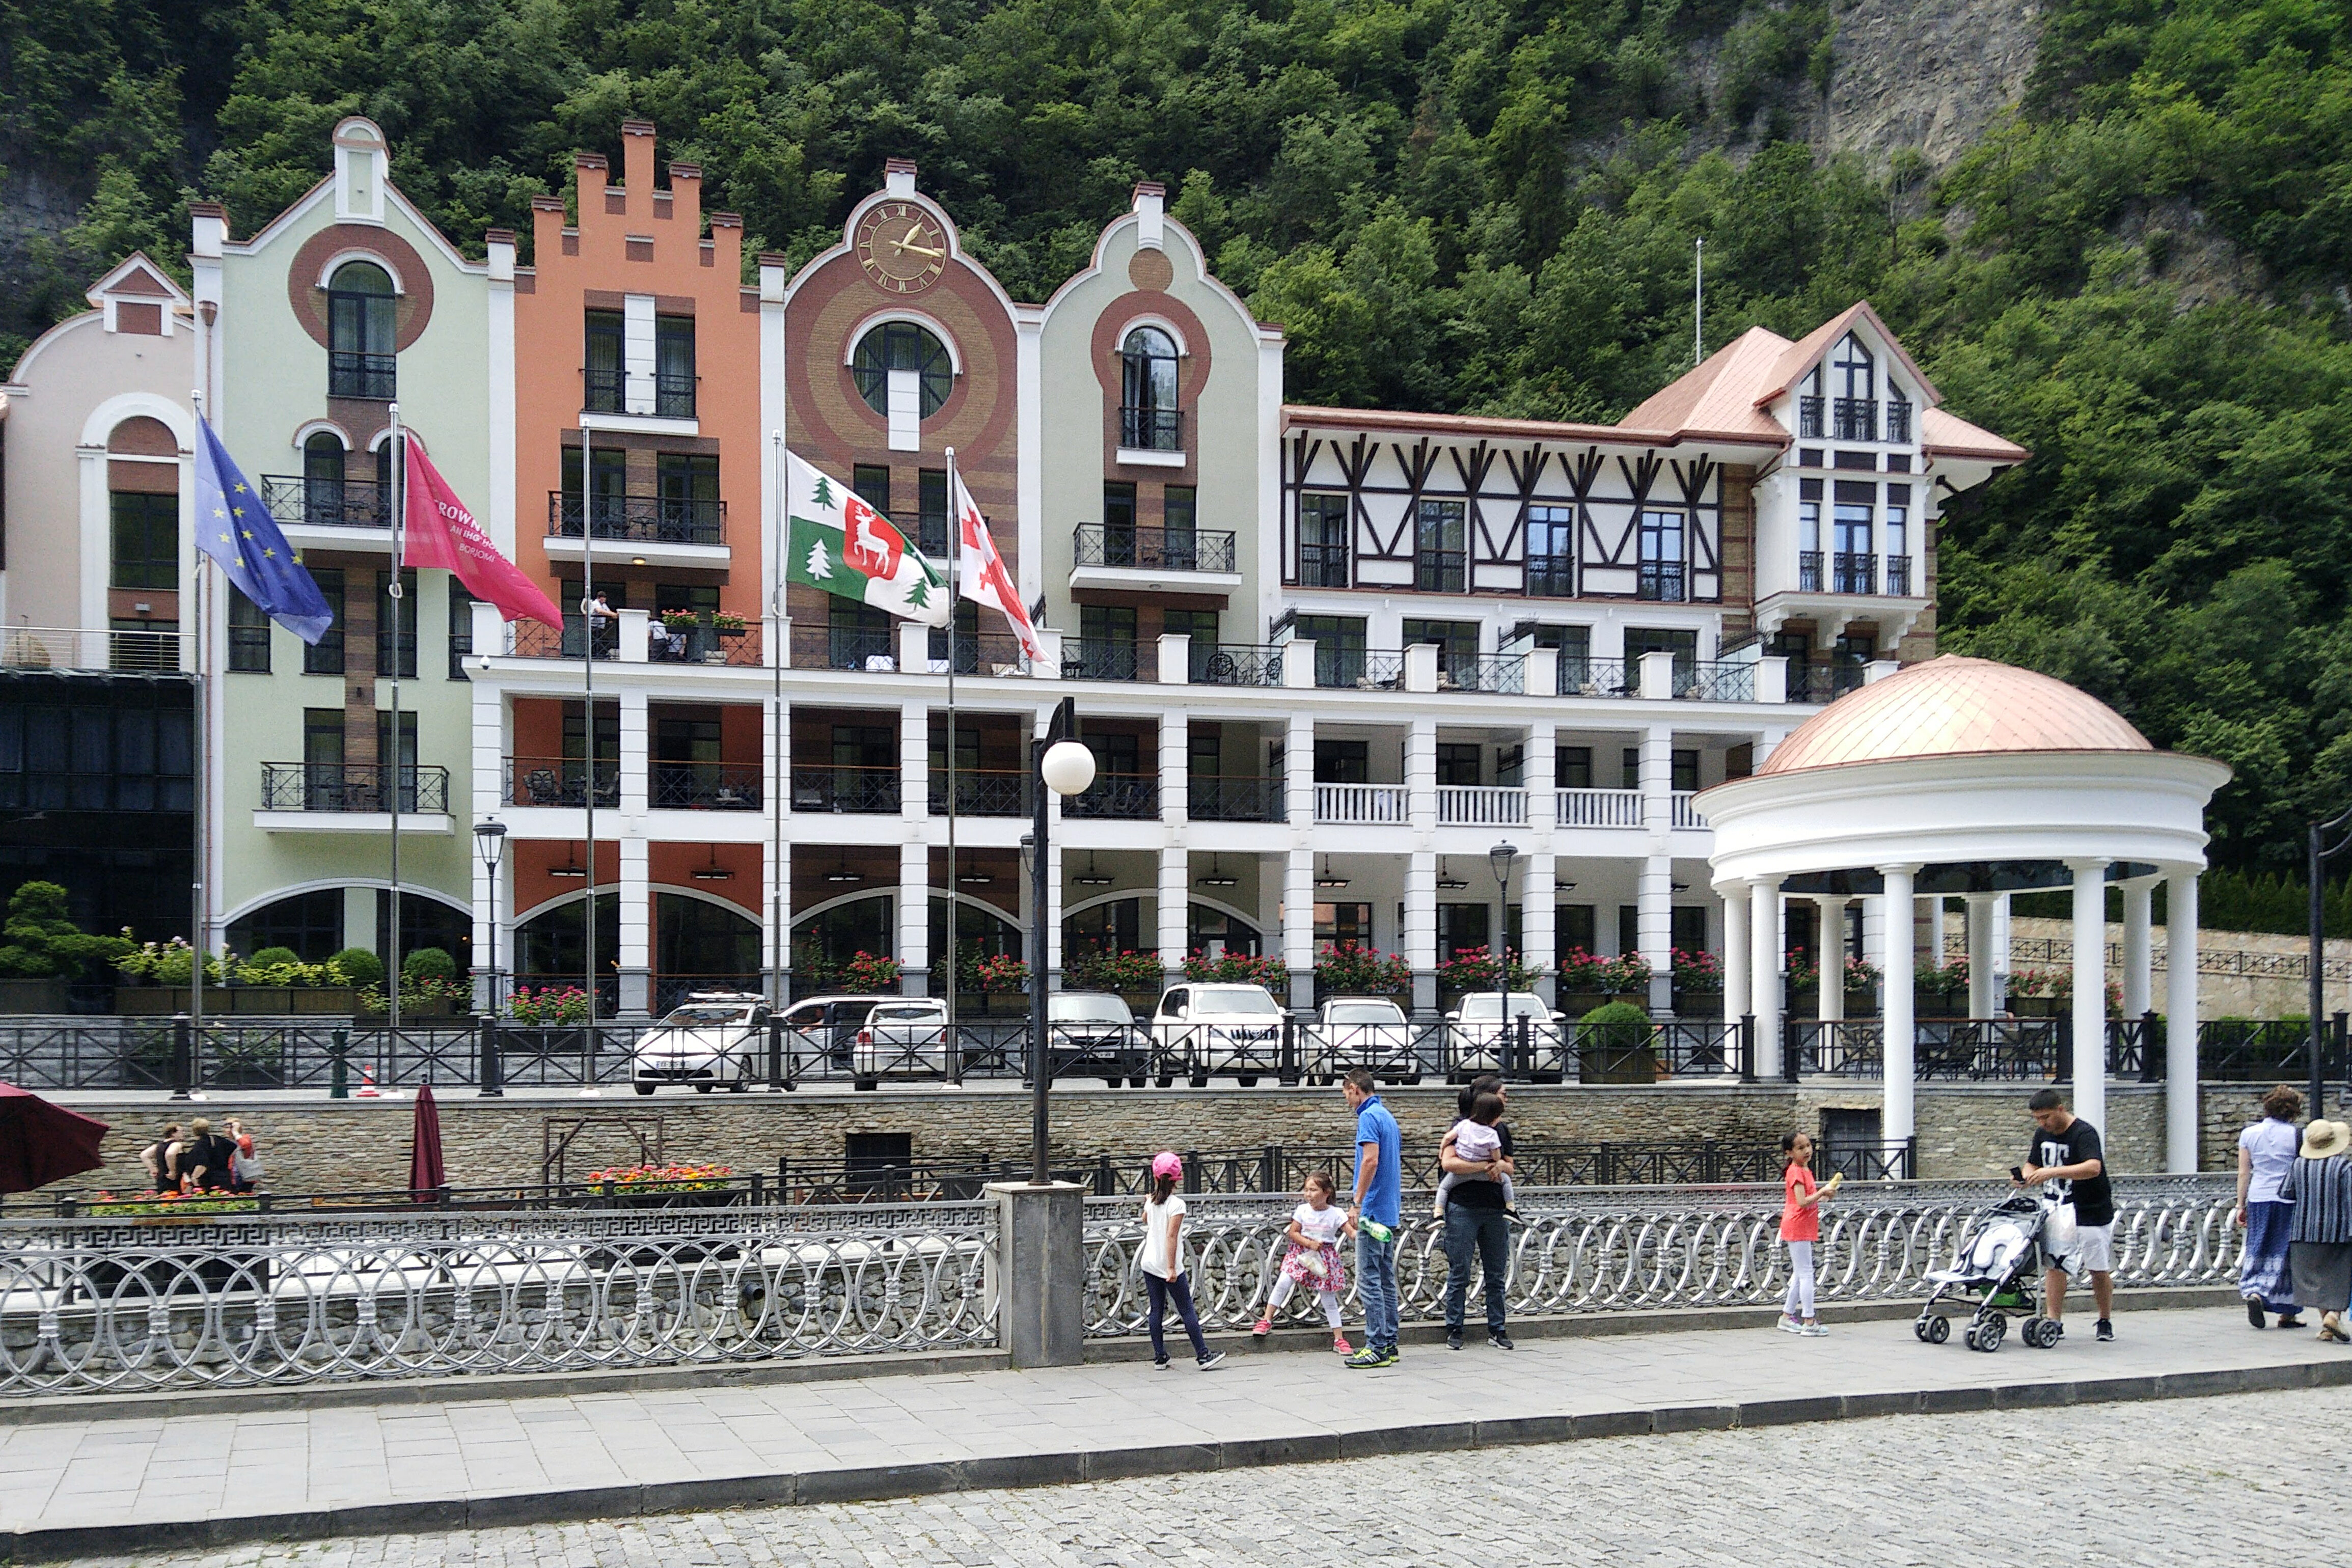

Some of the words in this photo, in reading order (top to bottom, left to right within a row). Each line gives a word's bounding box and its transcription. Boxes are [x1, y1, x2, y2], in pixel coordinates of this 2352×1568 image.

[434, 499, 487, 538] ROWN
[463, 530, 481, 542] IHG
[459, 543, 495, 563] BORJOMI
